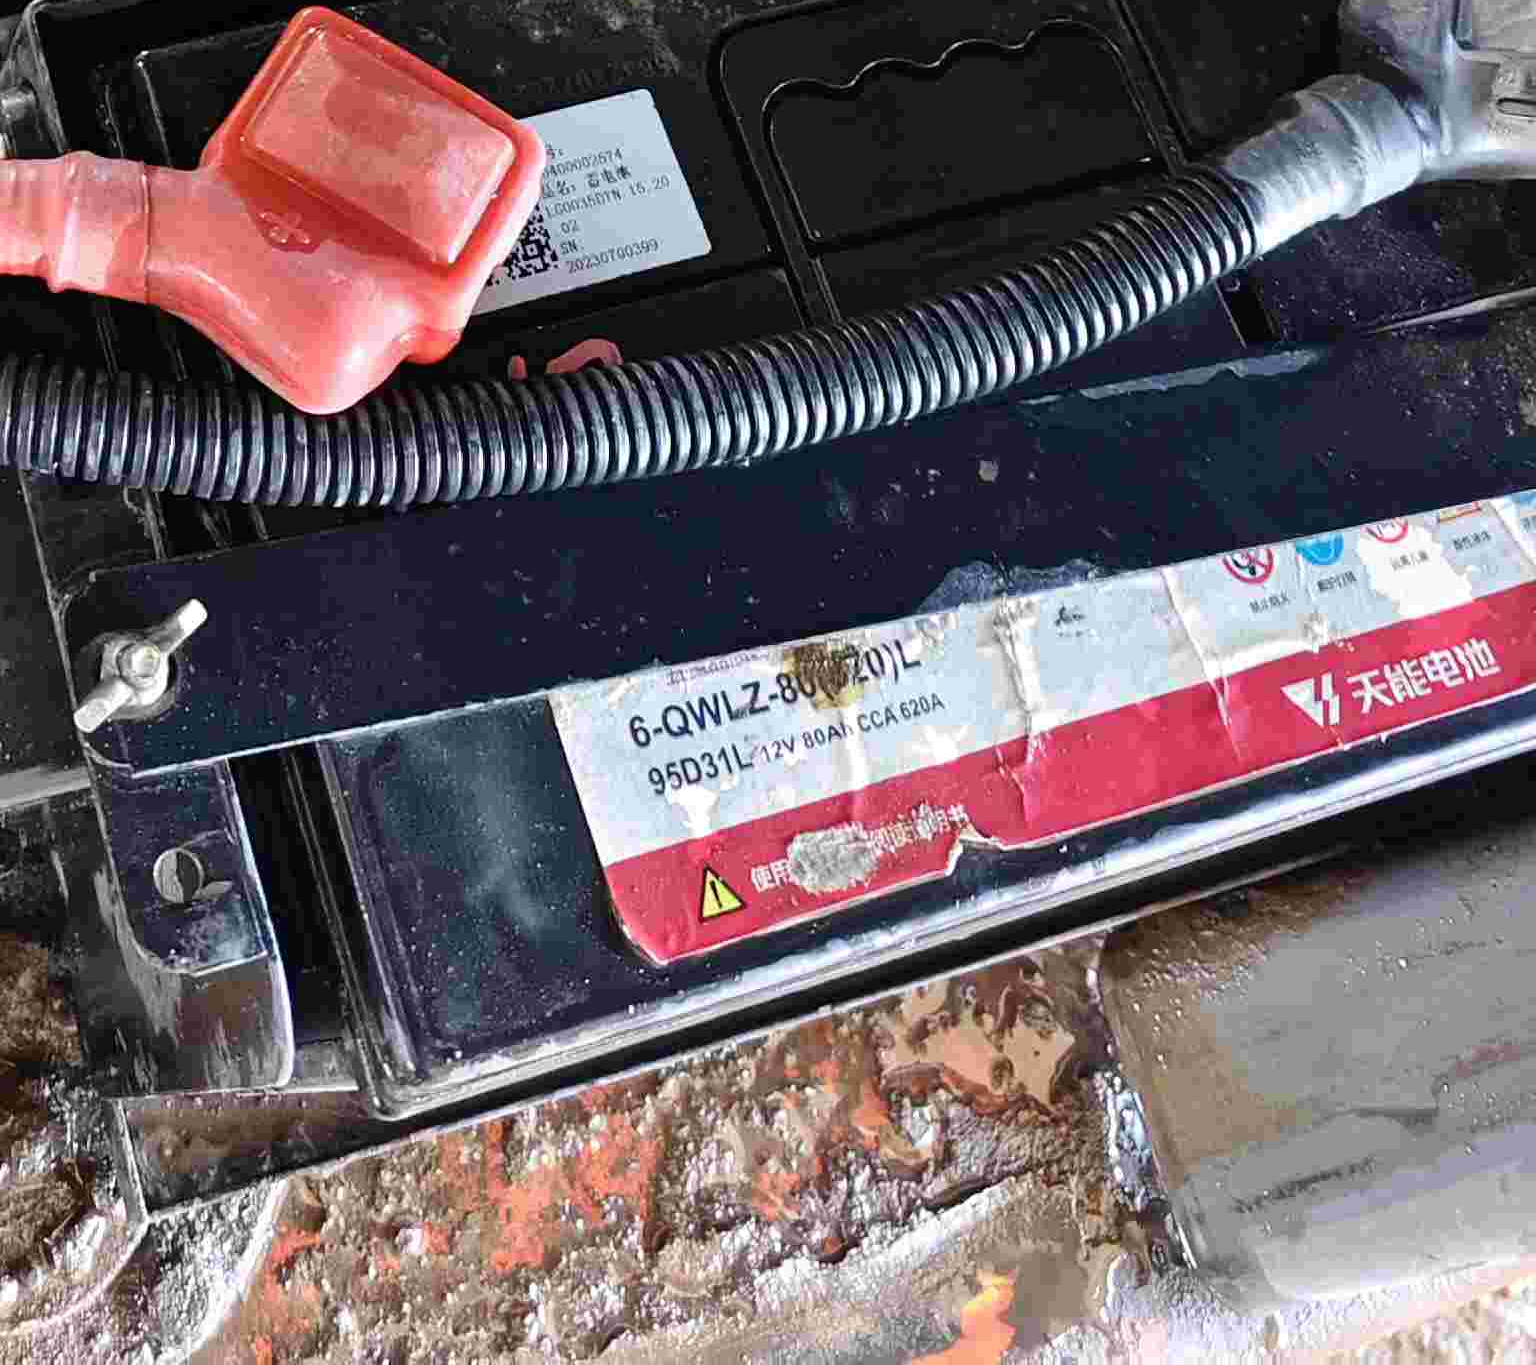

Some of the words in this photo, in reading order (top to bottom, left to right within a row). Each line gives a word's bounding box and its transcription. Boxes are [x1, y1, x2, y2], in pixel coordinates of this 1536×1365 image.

[1347, 637, 1501, 714] 天能电池
[648, 743, 754, 795] 95D31L
[762, 735, 796, 764] 12V
[857, 708, 898, 734] CCA
[901, 692, 945, 721] 620A
